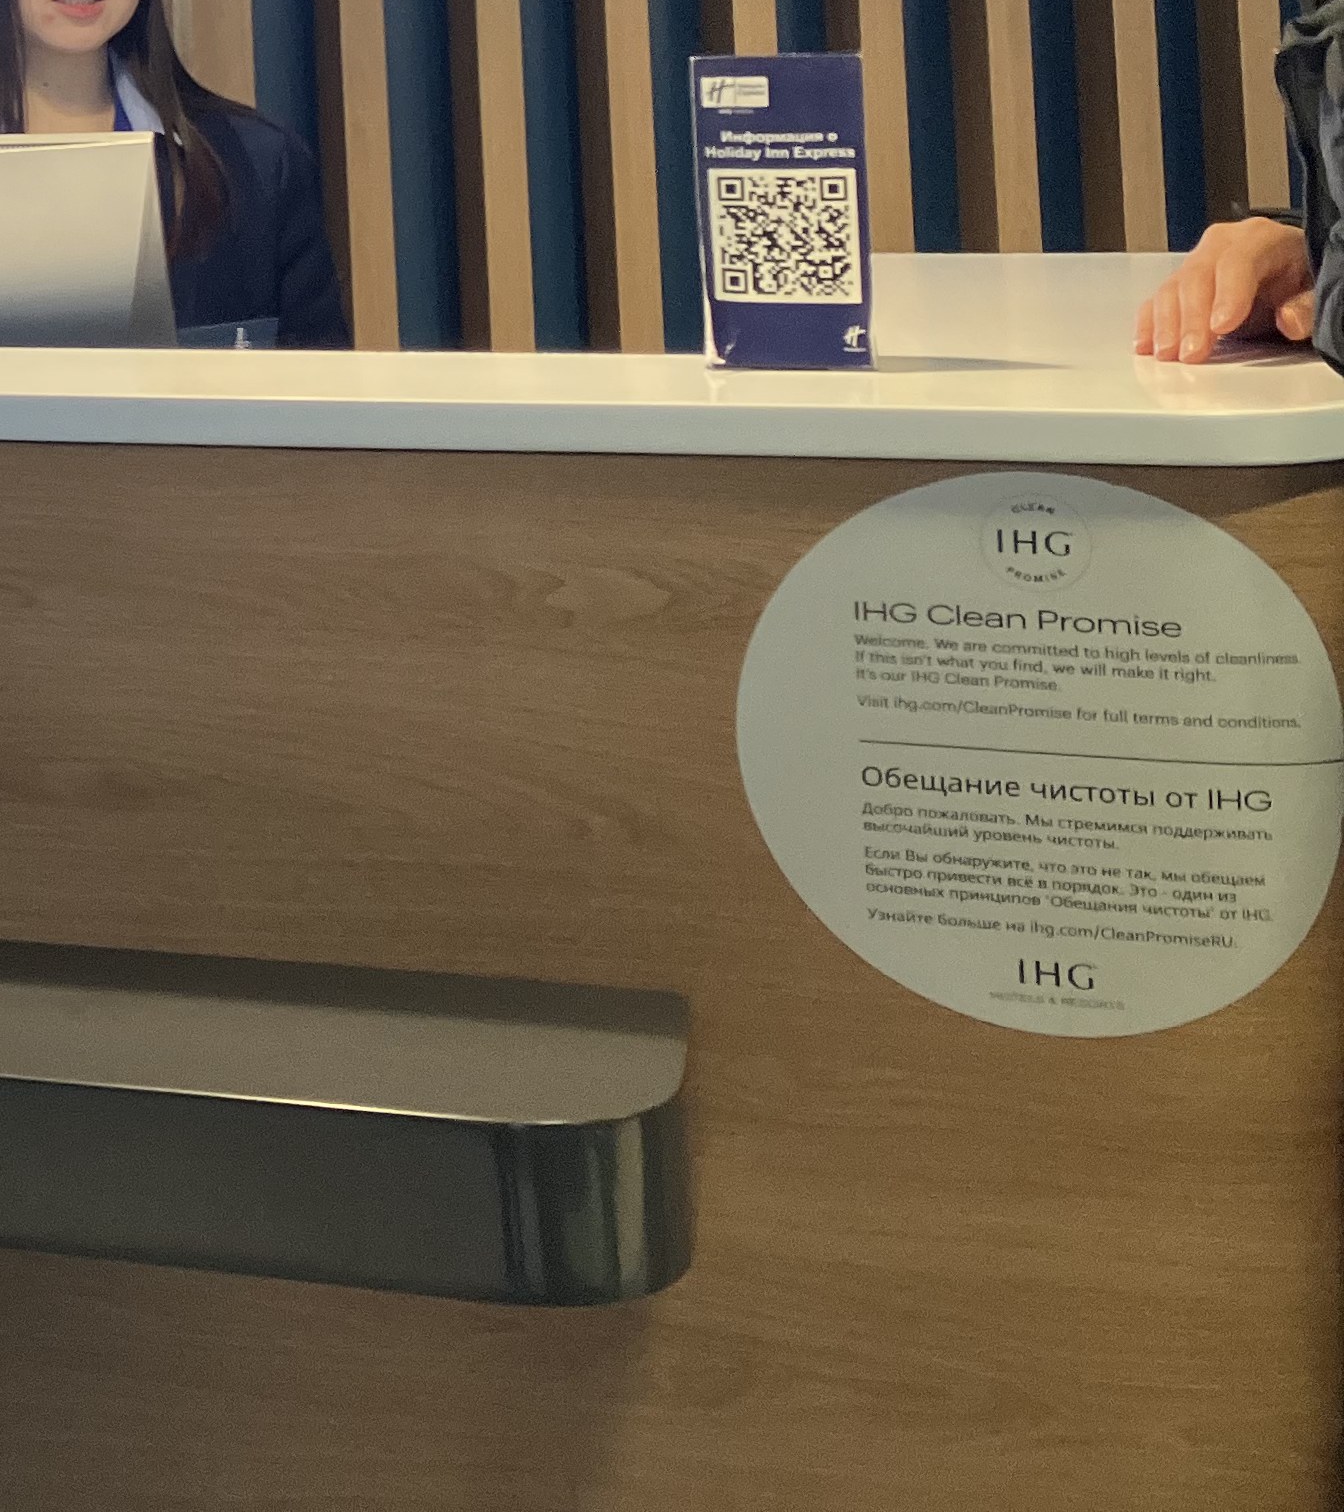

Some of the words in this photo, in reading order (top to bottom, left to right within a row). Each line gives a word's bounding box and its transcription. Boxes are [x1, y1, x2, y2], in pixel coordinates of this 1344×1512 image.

[704, 145, 762, 161] Holiday
[765, 147, 789, 159] Inn
[792, 145, 857, 161] Express
[1011, 502, 1056, 516] CLEAN
[996, 528, 1073, 556] IHG
[1006, 565, 1067, 583] PROMISE
[854, 600, 917, 624] IHG
[927, 603, 1027, 631] Clean
[1038, 609, 1183, 638] Promise
[855, 650, 865, 662] If
[869, 652, 897, 665] this
[901, 654, 932, 667] isn't
[937, 656, 974, 670] what
[980, 659, 1008, 672] you
[1013, 658, 1047, 675] find,
[1053, 664, 1075, 675] we
[1080, 664, 1106, 676] will
[1112, 666, 1154, 680] make
[1159, 668, 1169, 681] it
[1174, 668, 1216, 684] right.
[934, 638, 958, 652] We
[963, 642, 987, 653] are
[992, 642, 1079, 659] committed
[1084, 647, 1100, 659] to
[1105, 647, 1140, 664] high
[1145, 649, 1190, 664] levels
[1195, 651, 1210, 665] of
[856, 668, 877, 681] It's
[880, 671, 906, 682] our
[912, 671, 940, 684] IHG
[945, 673, 989, 687] Clean
[857, 694, 889, 709] Visit
[894, 696, 1072, 720] ihg.com/CleanPromise
[1077, 707, 1097, 721] for
[1103, 709, 1128, 724] full
[1133, 712, 1179, 727] terms
[1183, 714, 1213, 728] and
[1217, 714, 1301, 729] conditions.
[862, 766, 1020, 798] Обещание
[1030, 782, 1155, 807] чистоты
[1166, 791, 1198, 809] от
[1207, 789, 1272, 812] IHG
[862, 802, 913, 819] Добро
[1025, 813, 1053, 827] Мы
[1058, 817, 1148, 836] стремимся
[1152, 823, 1273, 842] поддерживать
[863, 821, 969, 838] высочайший
[973, 829, 1043, 844] уровень
[1047, 834, 1119, 851] чистоты.
[865, 846, 901, 861] Если
[905, 849, 928, 863] Вы
[933, 852, 1034, 872] обнаружите,
[1039, 862, 1067, 875] что
[1070, 864, 1097, 877] это
[1101, 867, 1122, 878] не
[1161, 871, 1187, 883] мы
[1191, 871, 1266, 888] обещаем
[865, 863, 923, 881] быстро
[927, 869, 1002, 887] привести
[1038, 878, 1048, 889] в
[1129, 882, 1158, 898] Это
[1172, 889, 1213, 904] один
[1218, 892, 1237, 904] из
[866, 882, 944, 900] основных
[948, 888, 1041, 906] принципов
[1219, 909, 1238, 922] от
[867, 907, 934, 925] Узнайте
[937, 913, 1001, 931] больше
[1005, 920, 1025, 933] на
[1018, 958, 1097, 991] IHG
